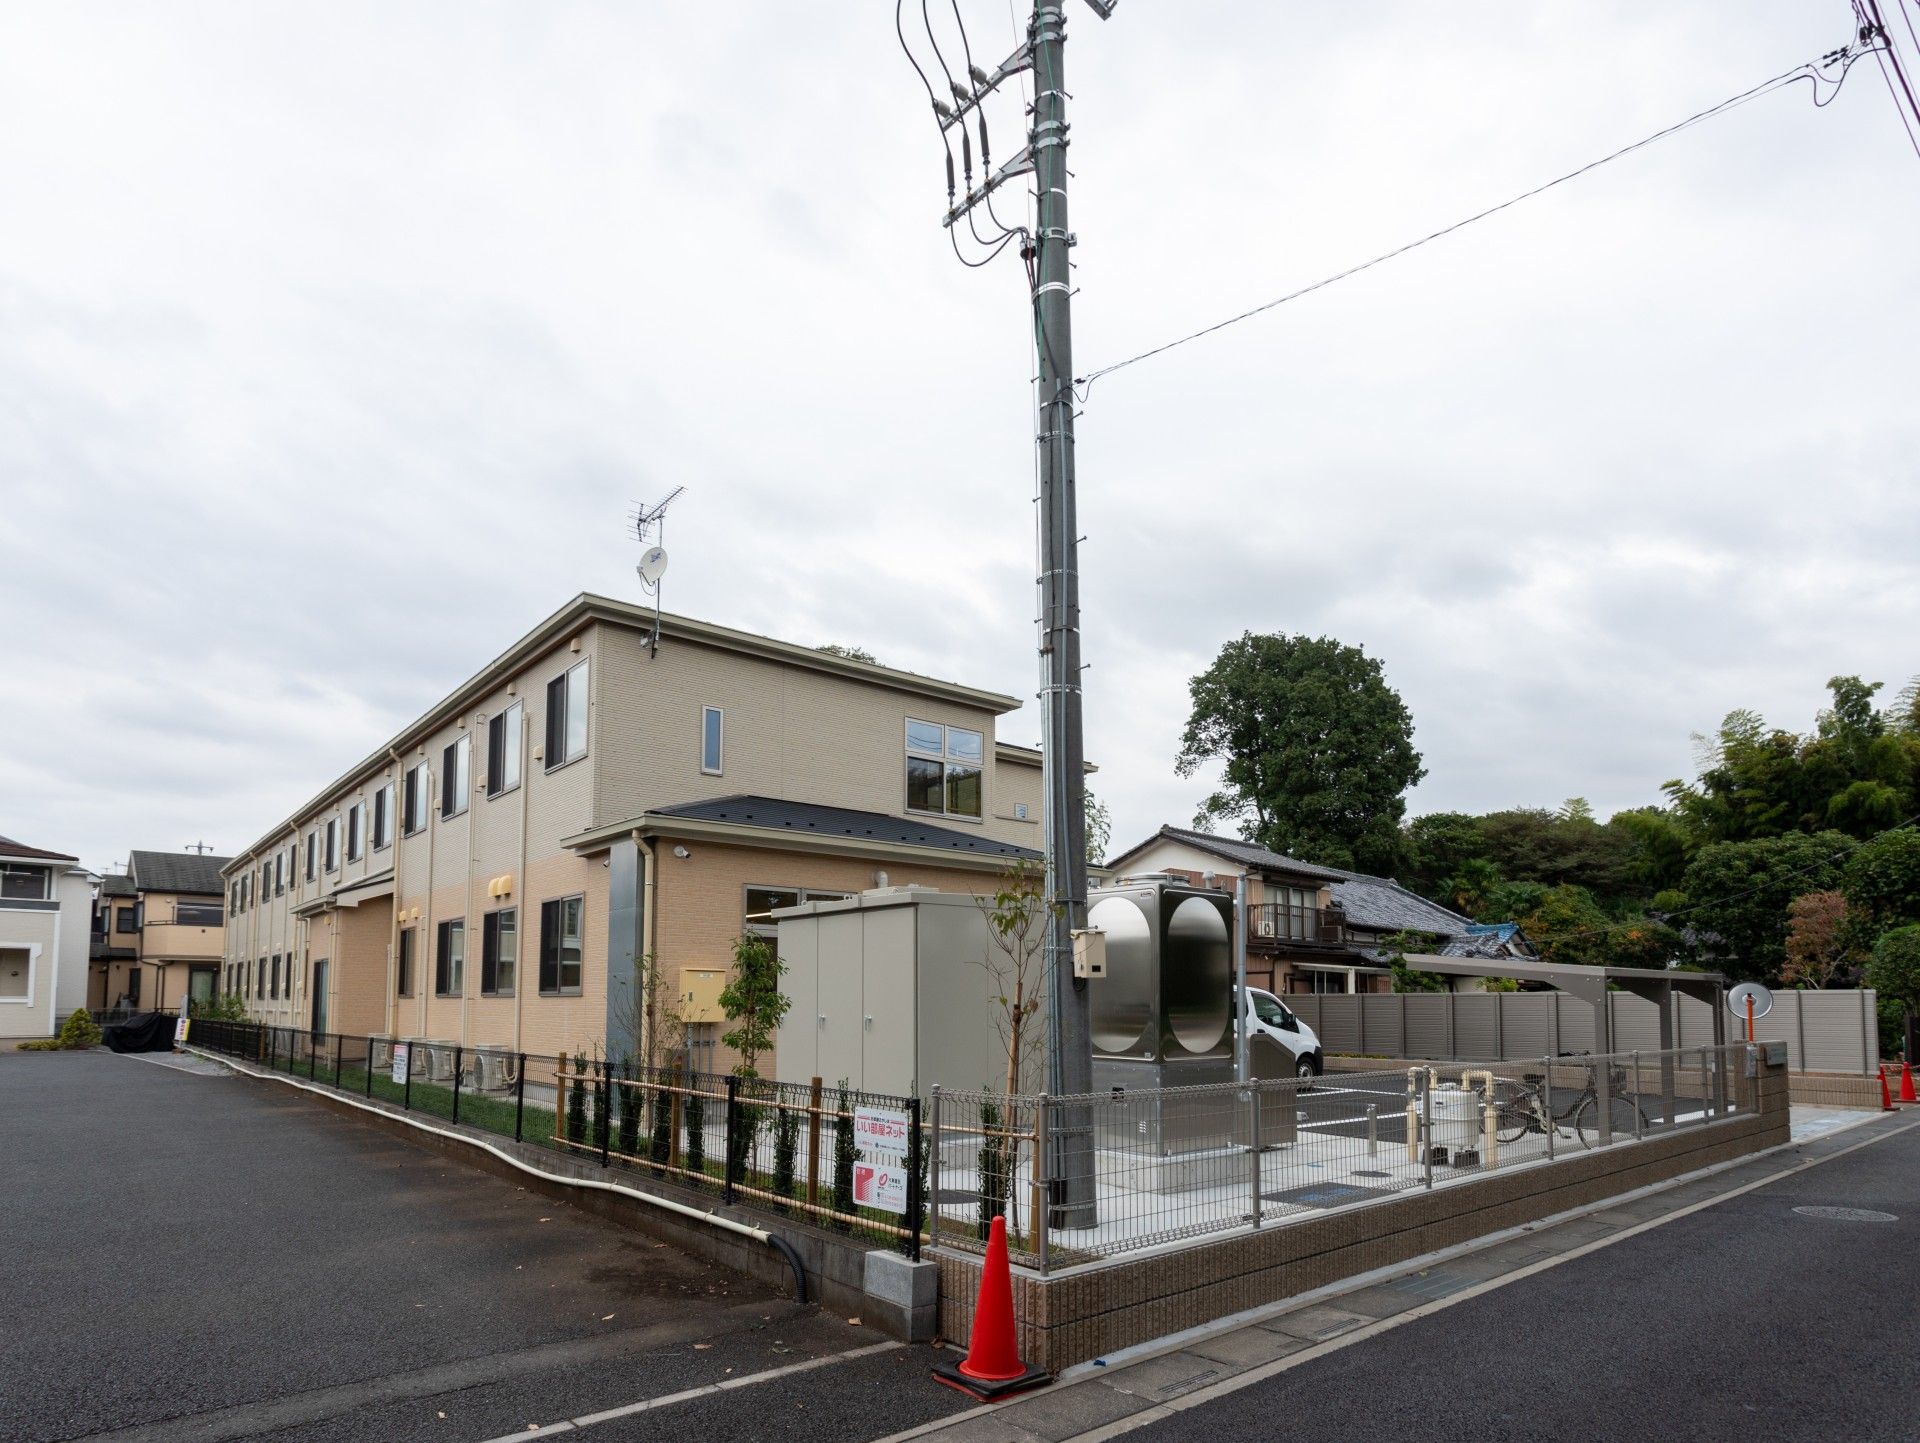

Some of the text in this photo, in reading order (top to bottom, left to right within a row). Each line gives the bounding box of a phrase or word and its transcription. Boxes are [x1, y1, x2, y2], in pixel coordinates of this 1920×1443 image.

[856, 1120, 905, 1138] いい部屋ネット
